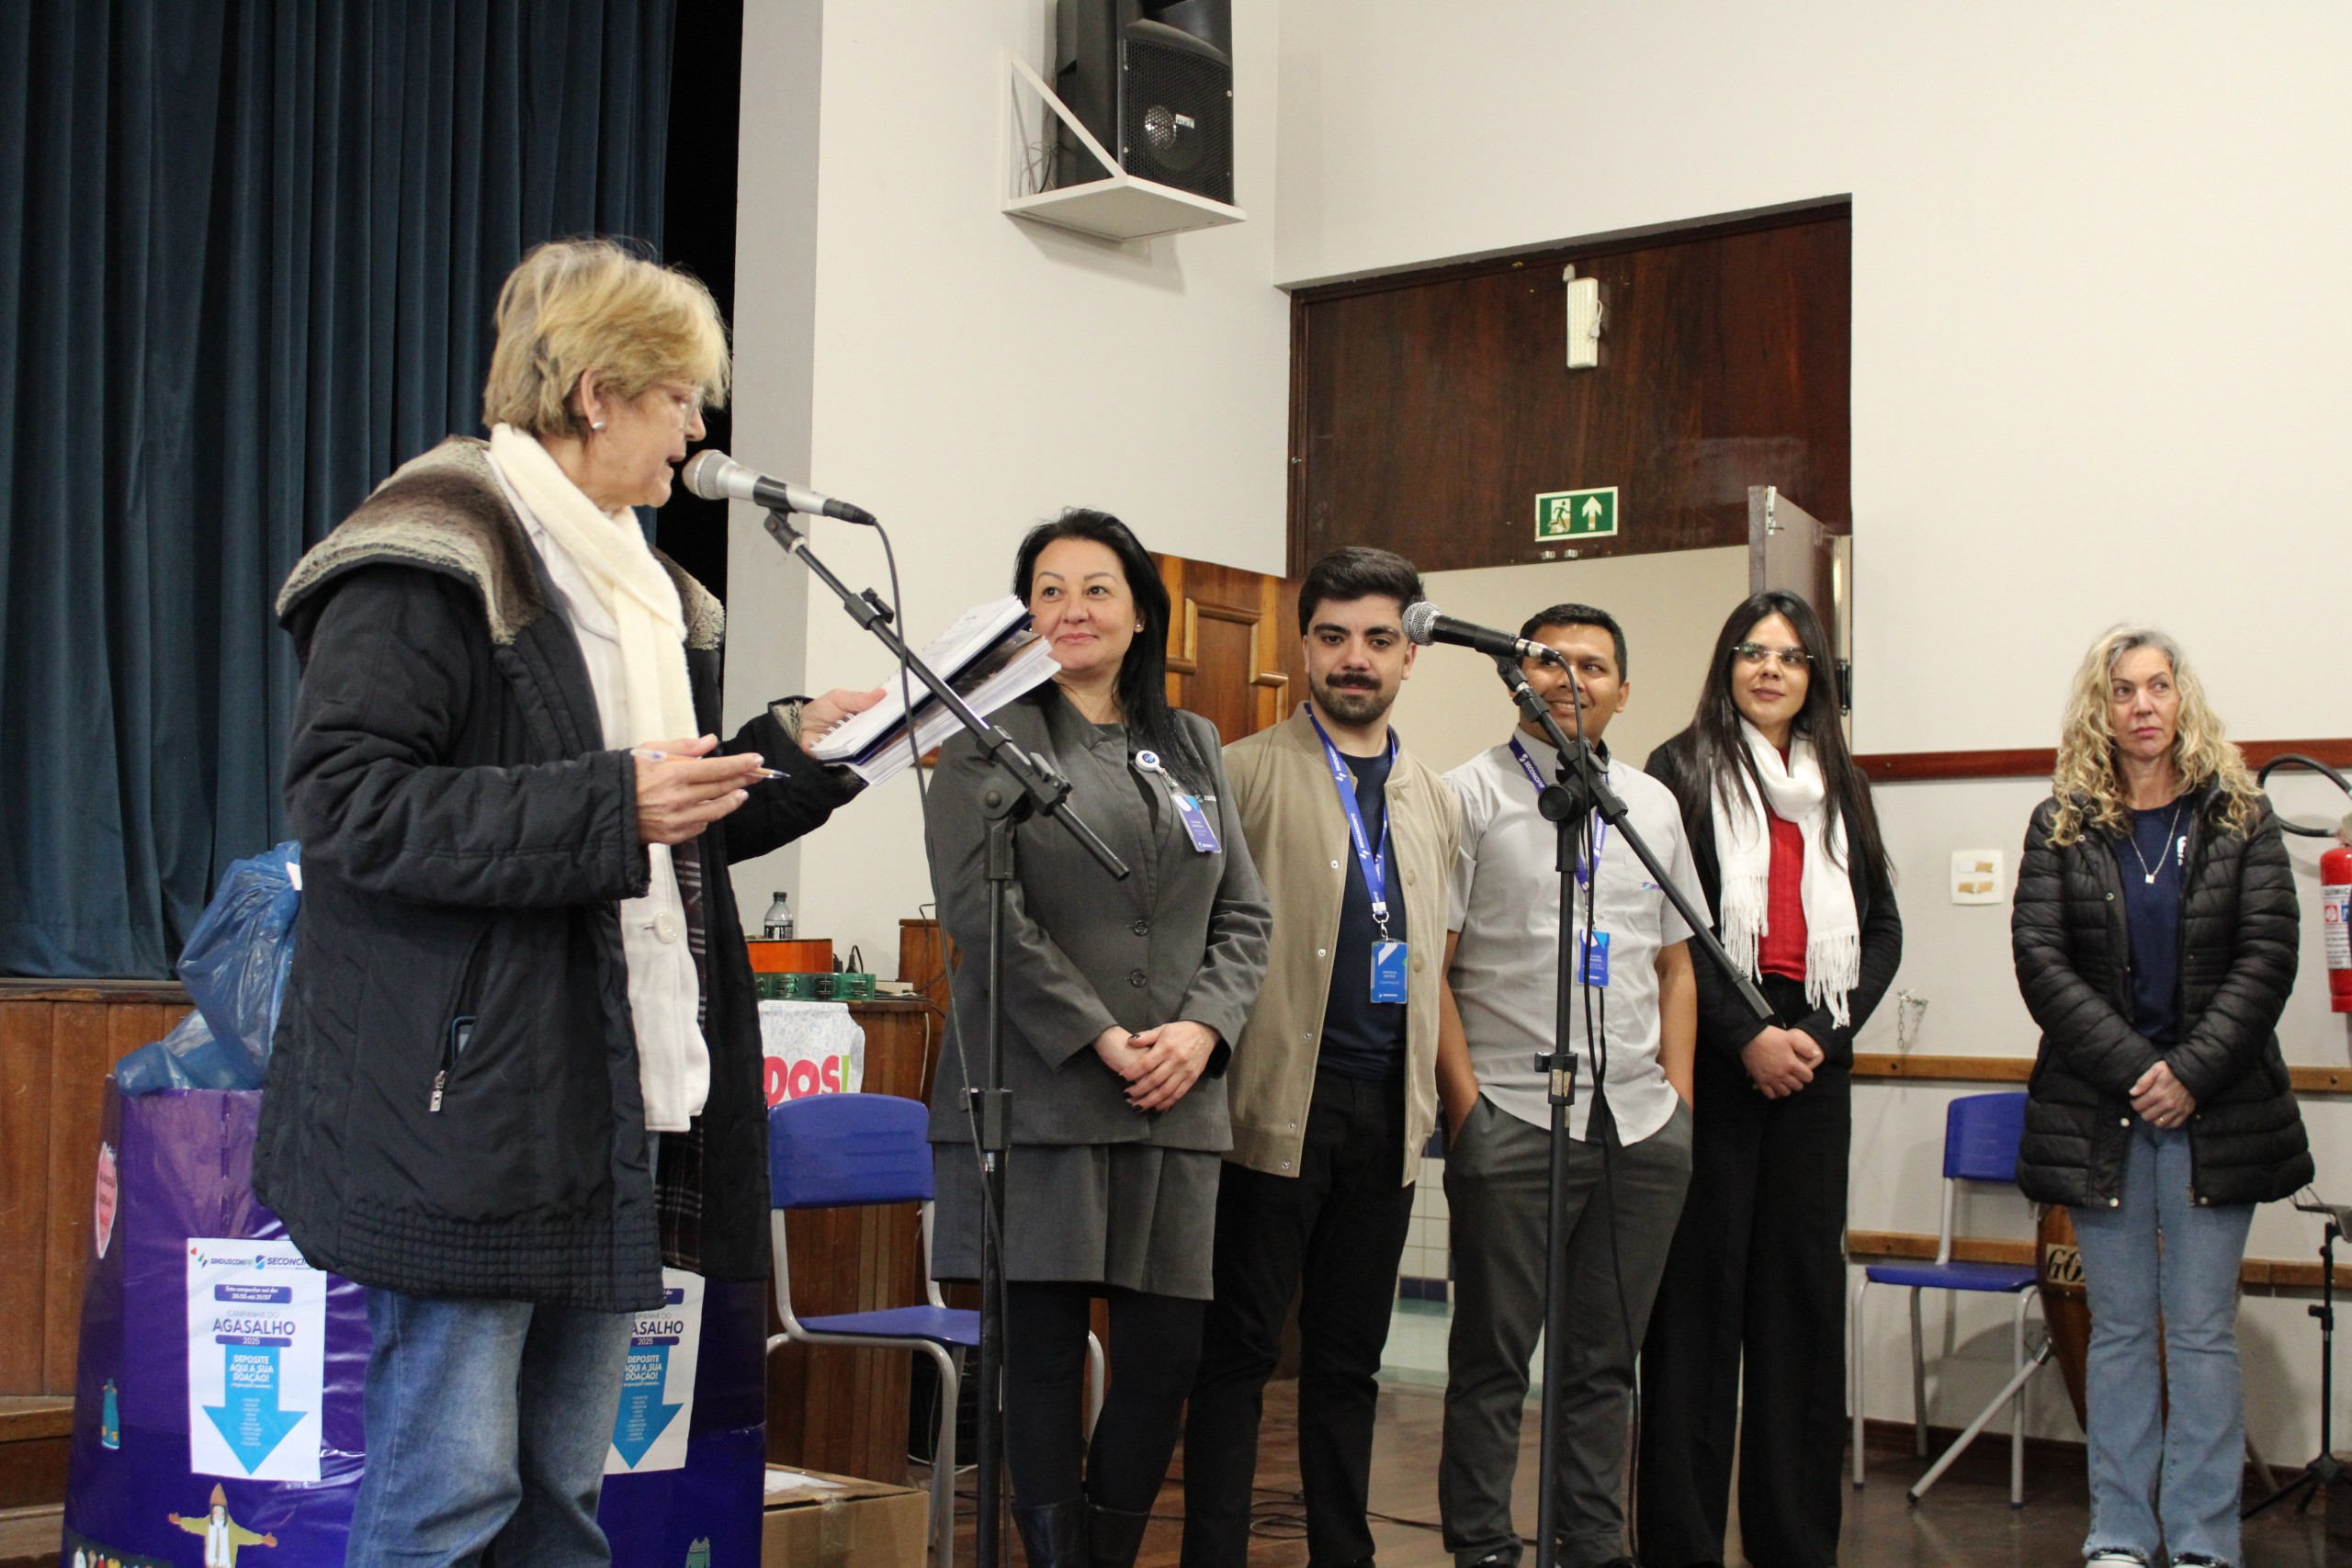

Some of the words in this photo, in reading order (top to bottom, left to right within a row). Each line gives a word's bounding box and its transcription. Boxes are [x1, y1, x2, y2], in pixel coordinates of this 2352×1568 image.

[228, 1310, 265, 1318] CAMPANHA
[212, 1318, 296, 1335] AGASALHO
[243, 1337, 261, 1345] 2025
[233, 1355, 270, 1364] DEPOSITE
[628, 1354, 660, 1363] DEPOSITE
[229, 1363, 249, 1373] AQUI
[256, 1365, 274, 1373] SUA
[649, 1363, 662, 1371] SUA
